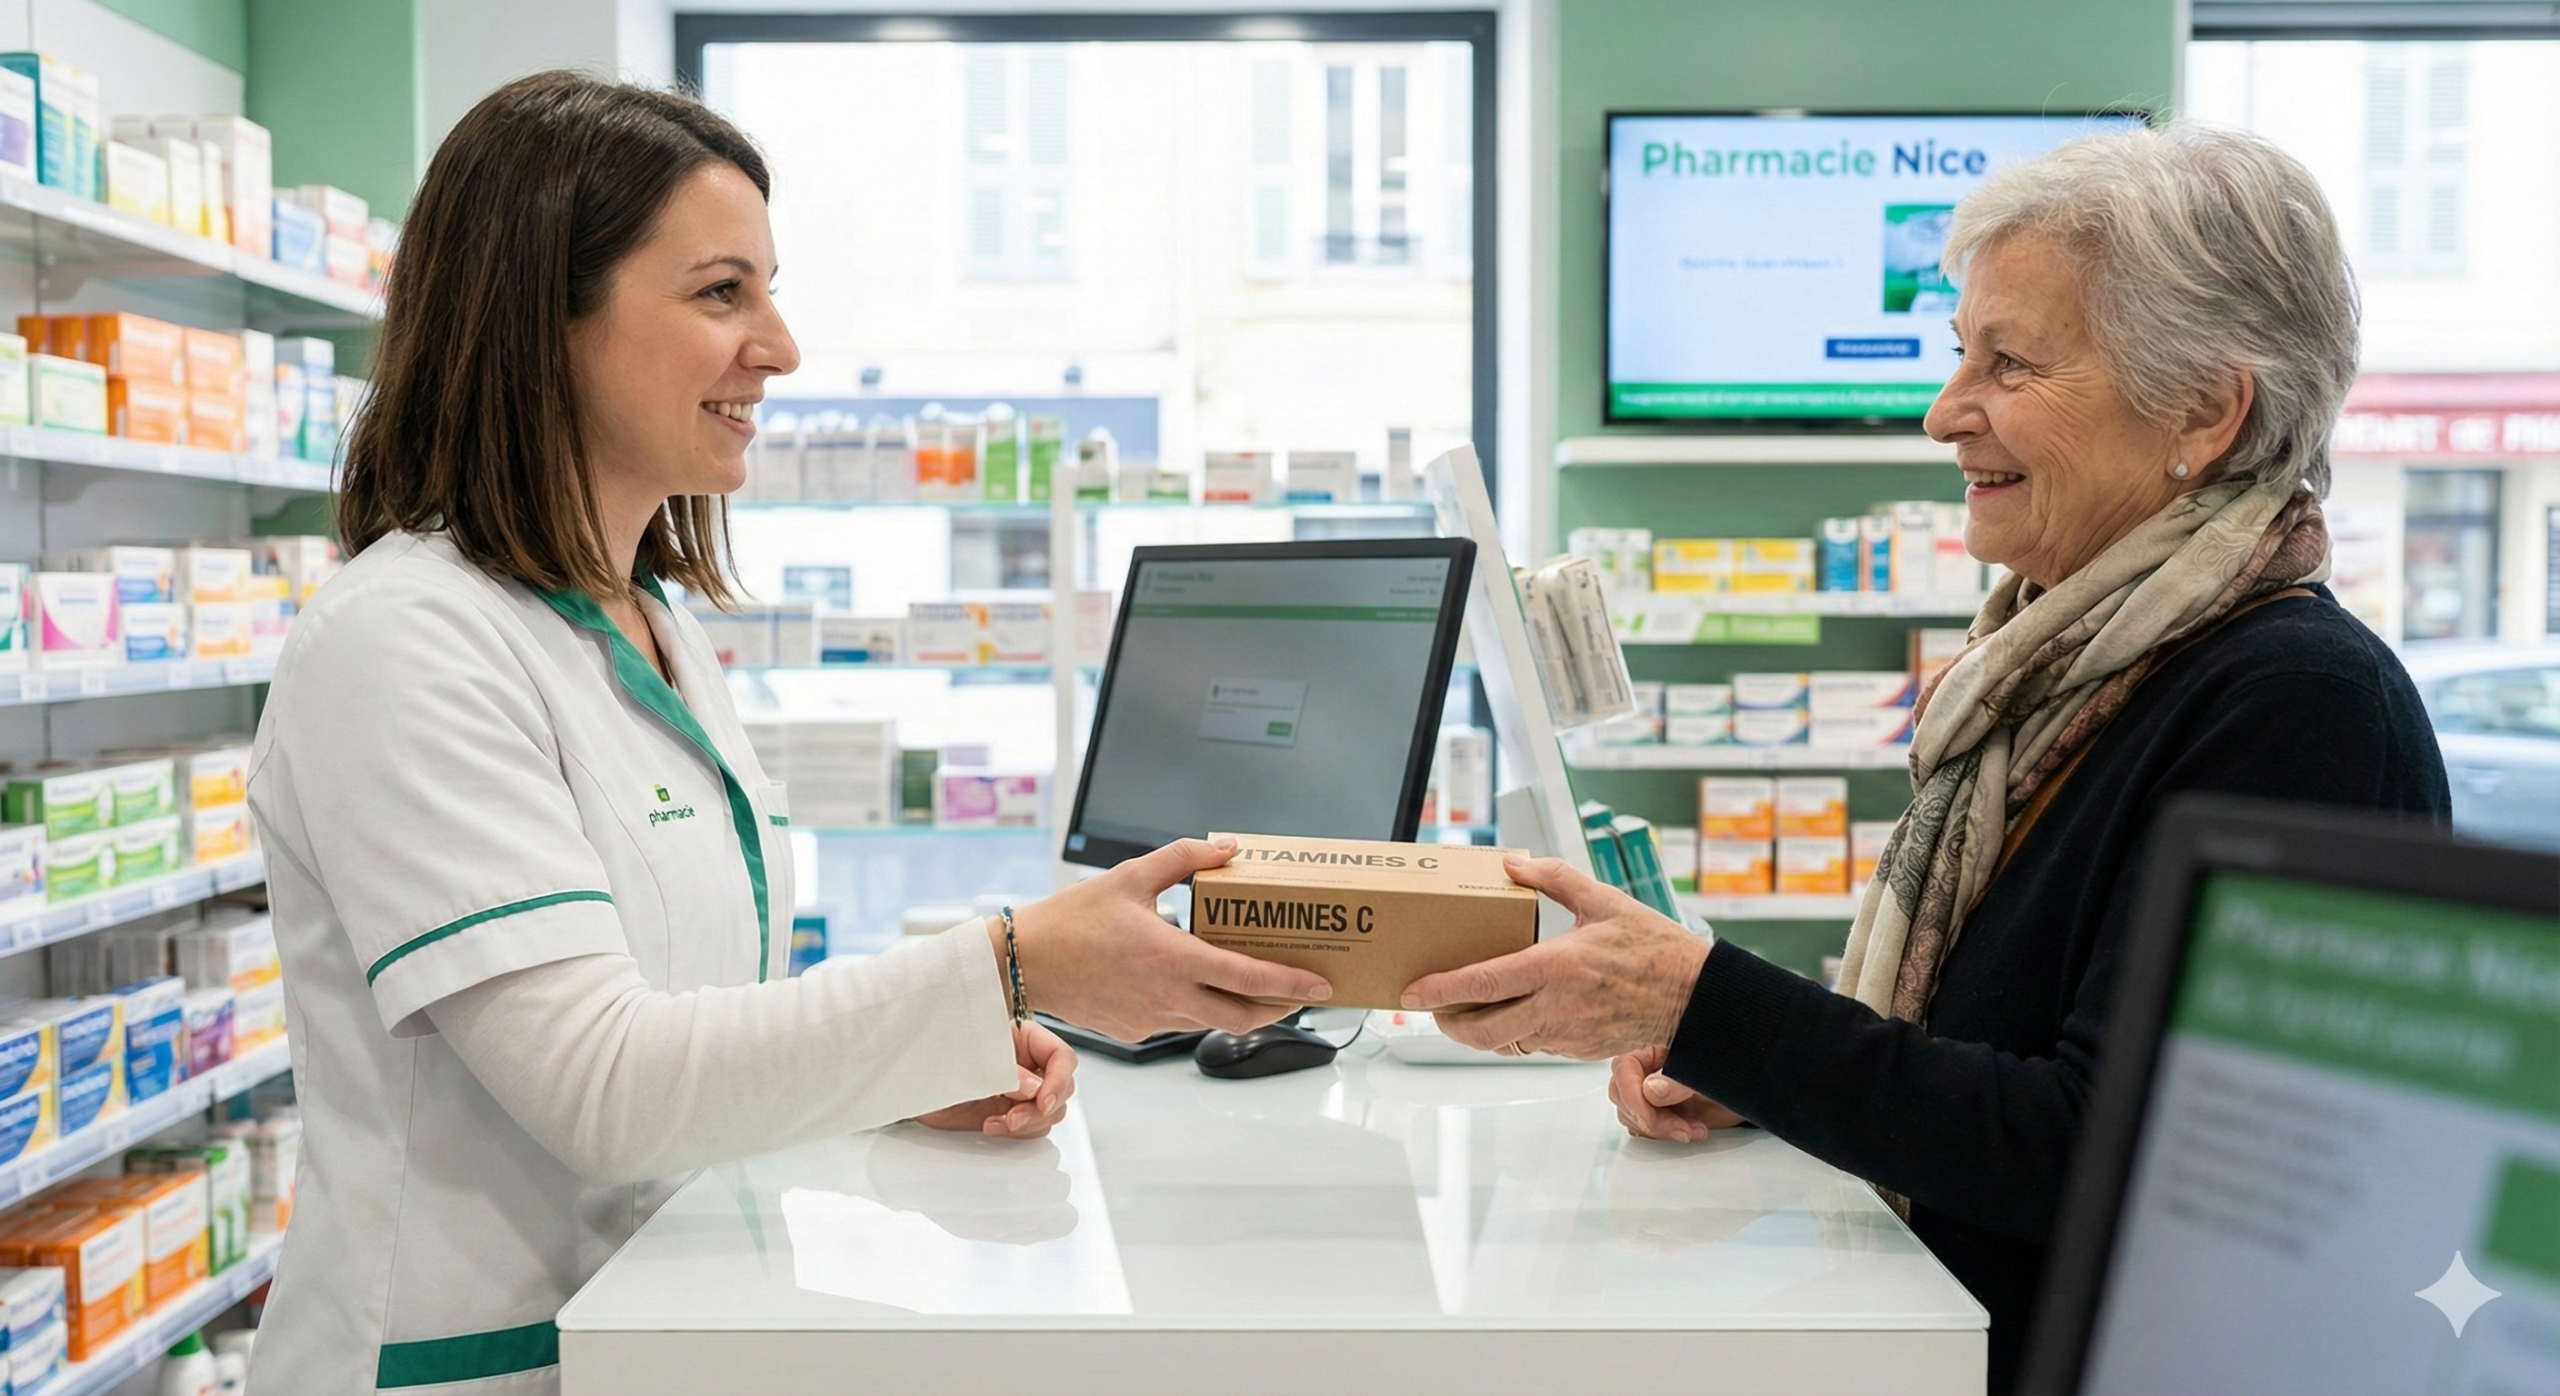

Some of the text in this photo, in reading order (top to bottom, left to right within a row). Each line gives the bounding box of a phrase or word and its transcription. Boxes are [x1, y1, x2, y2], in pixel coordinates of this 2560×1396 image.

[1642, 138, 1988, 177] Pharmacie Nice
[649, 804, 695, 827] pharmacie
[1417, 857, 1439, 870] C
[1204, 897, 1374, 935] VITAMINES C
